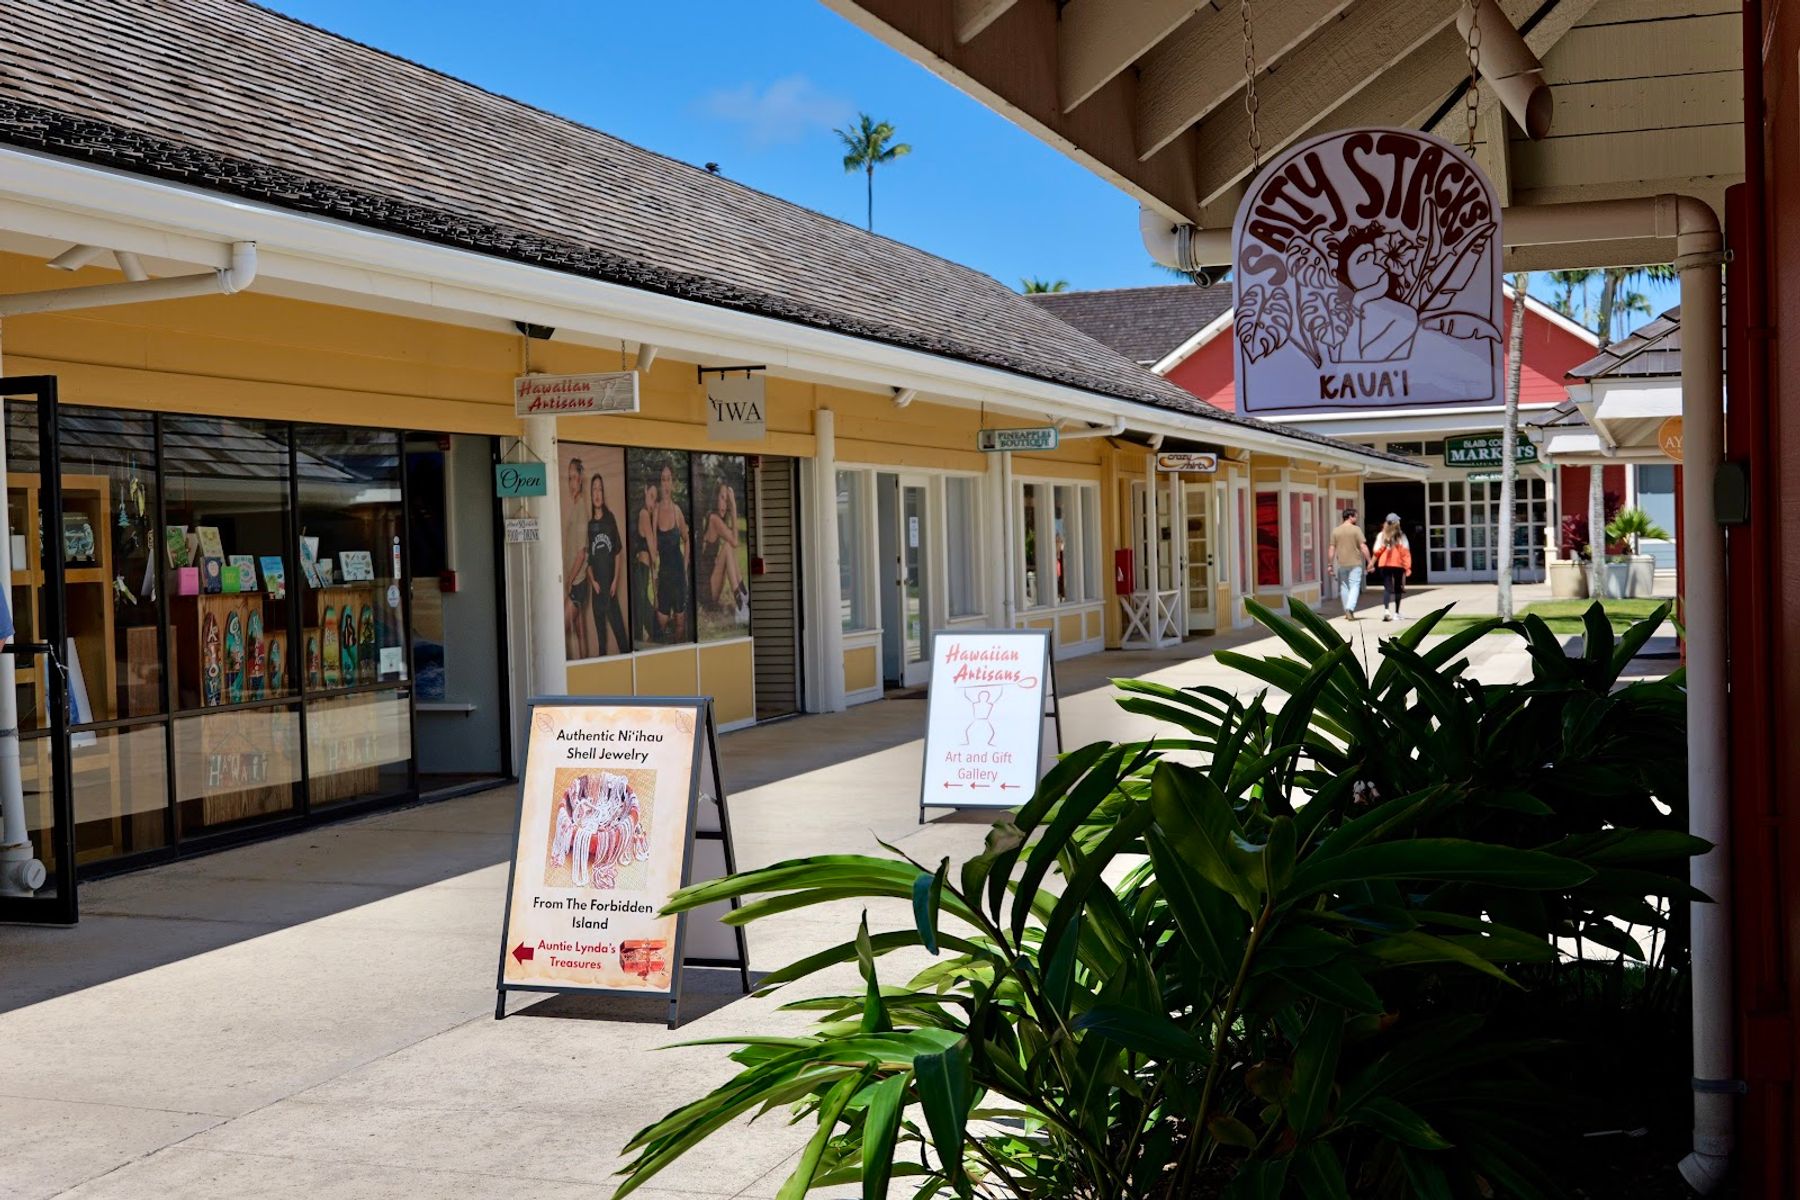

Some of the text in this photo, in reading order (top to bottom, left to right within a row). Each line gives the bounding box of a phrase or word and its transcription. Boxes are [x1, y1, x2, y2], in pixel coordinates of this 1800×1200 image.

[1241, 133, 1489, 286] SALTY STACKS
[519, 379, 592, 398] Hawaiian
[528, 397, 594, 412] Artisans
[997, 430, 1051, 440] PINEAPPLES
[1000, 439, 1050, 448] BOUTIQUE
[1451, 445, 1535, 461] MARKTS
[500, 468, 542, 494] Open
[945, 643, 1021, 664] Hawaiian
[952, 663, 1022, 683] Artisans
[556, 729, 615, 742] Authentic
[566, 747, 649, 763] Shell Jewelry
[944, 751, 1013, 764] Art and Gift
[957, 767, 999, 783] Gallery
[533, 896, 653, 914] From The Forbidden
[571, 916, 609, 930] Island
[538, 939, 616, 955] Auntie Lynda's
[550, 956, 602, 970] Treasures
